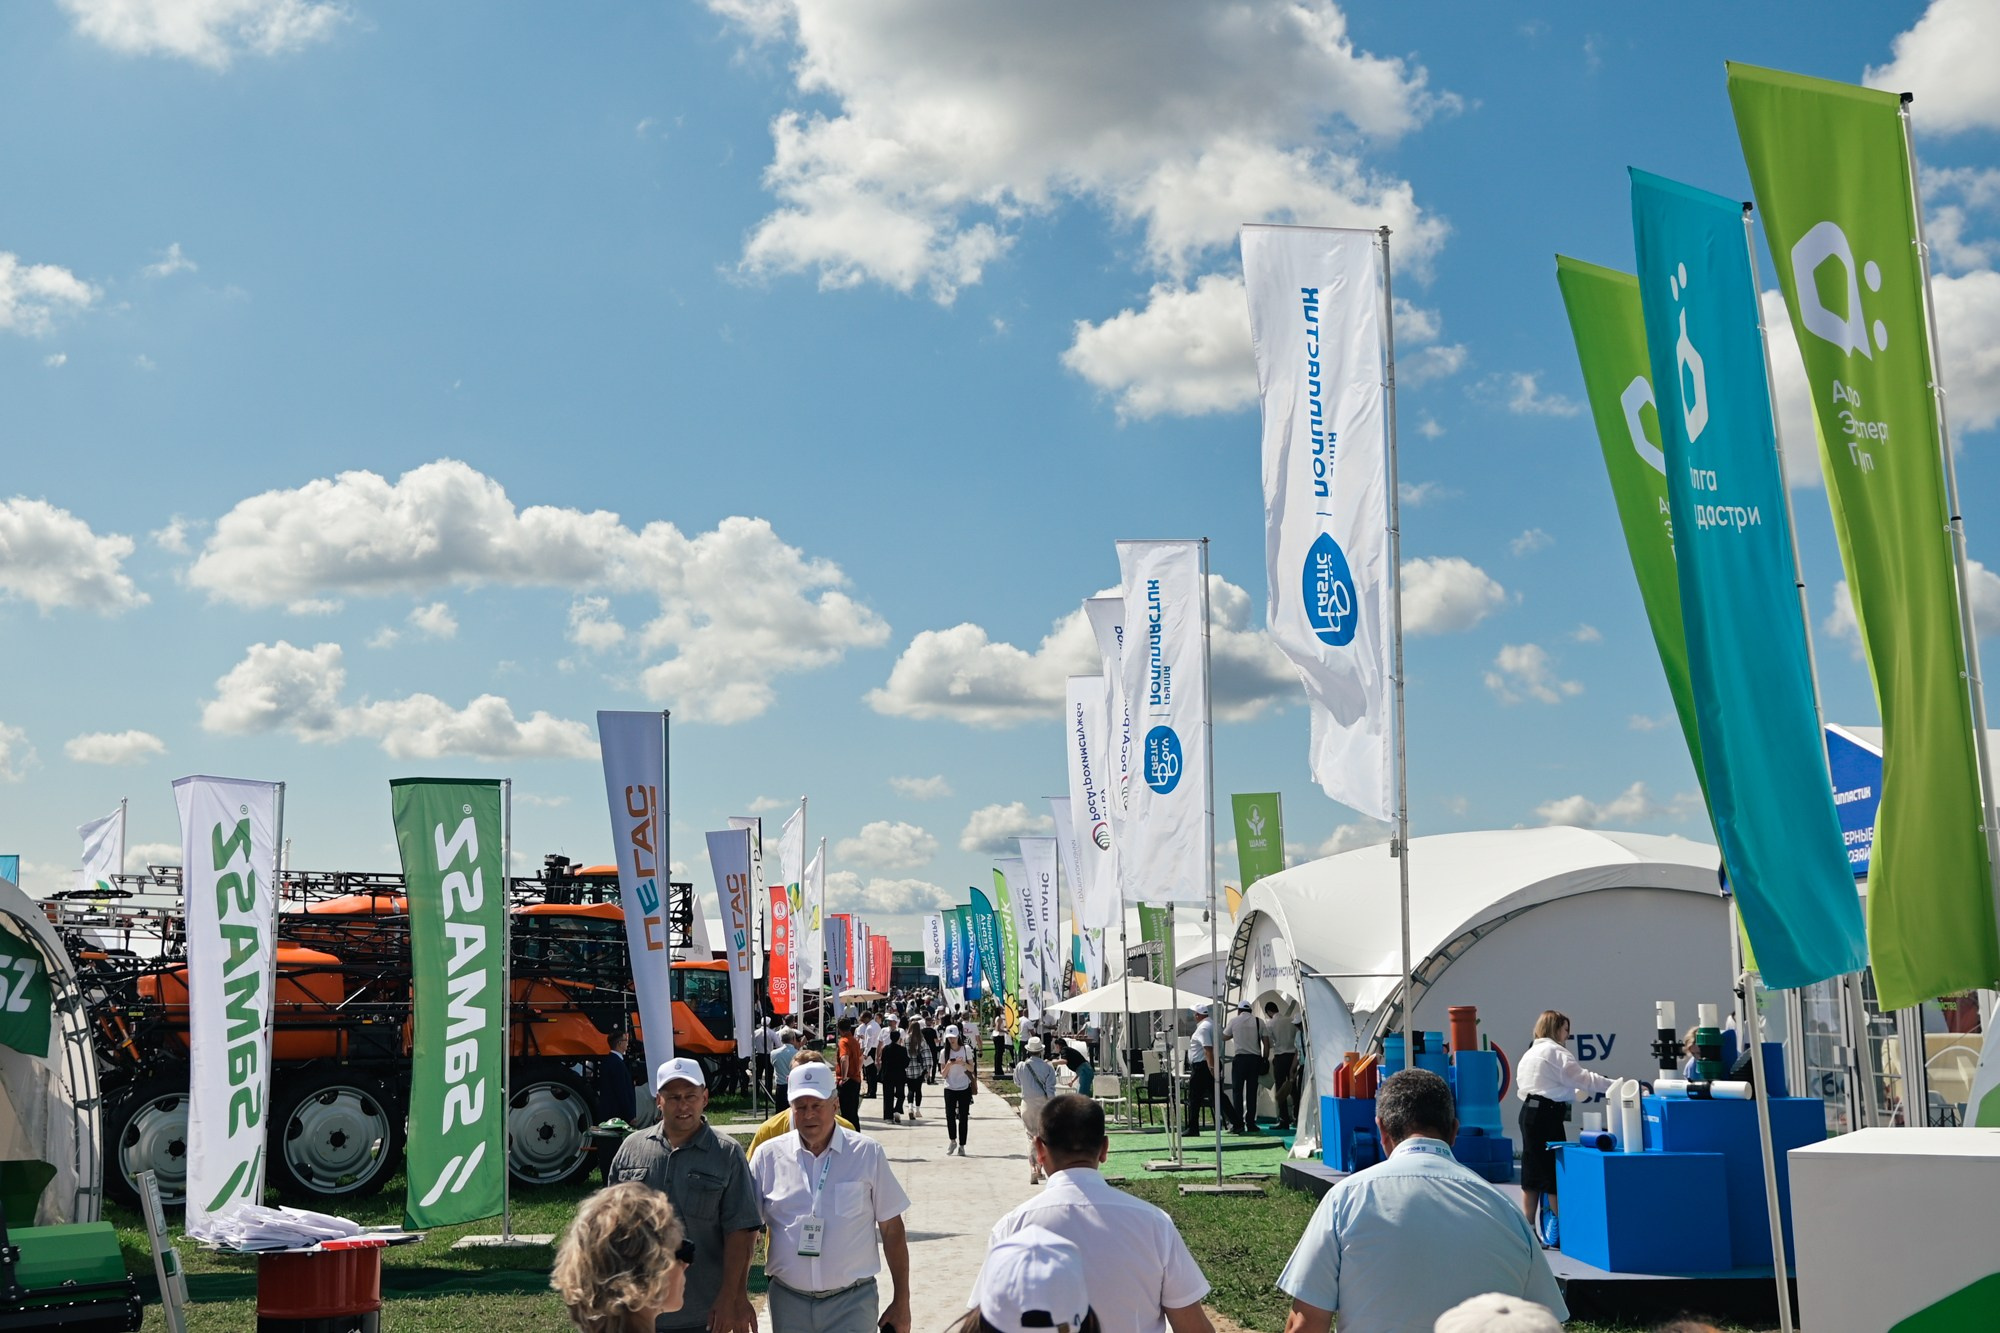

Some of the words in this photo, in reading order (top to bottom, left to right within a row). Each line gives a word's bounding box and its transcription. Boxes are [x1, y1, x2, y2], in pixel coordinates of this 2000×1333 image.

[1694, 504, 1761, 534] дастри
[625, 784, 664, 952] ПЕГАС
[1843, 826, 1874, 846] ЕРНЫЕ
[726, 873, 749, 972] ПЕГАС
